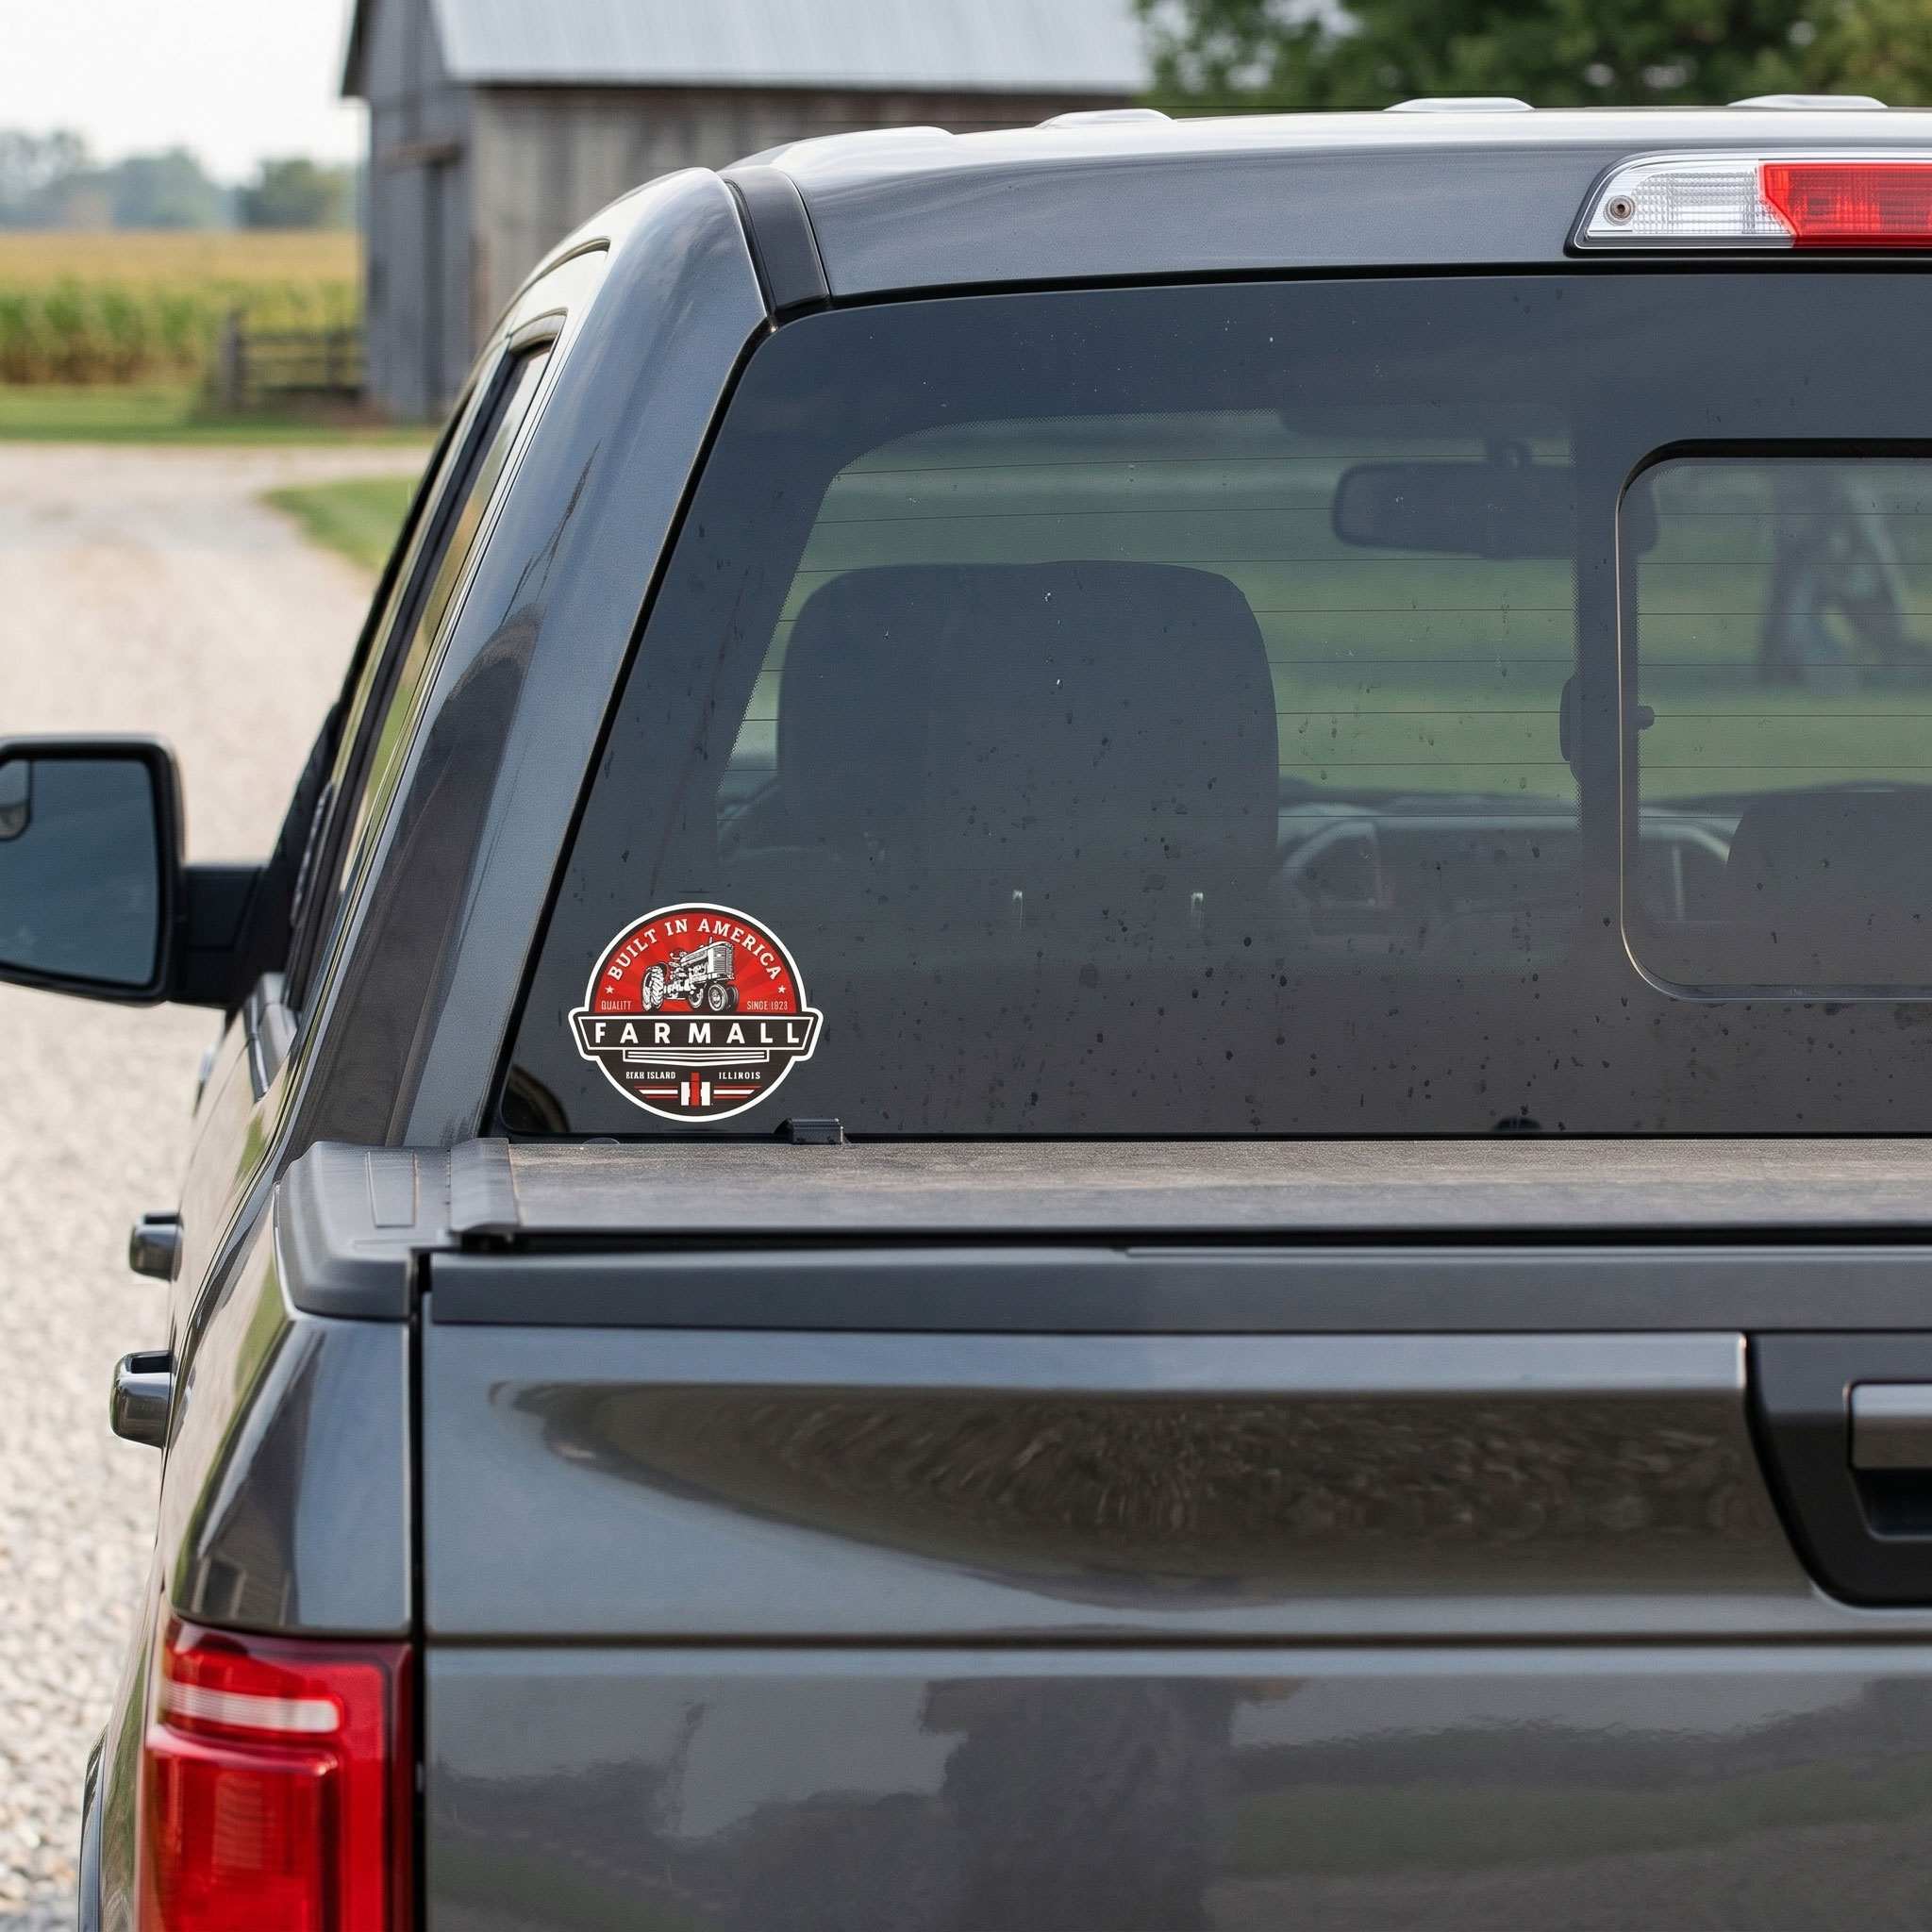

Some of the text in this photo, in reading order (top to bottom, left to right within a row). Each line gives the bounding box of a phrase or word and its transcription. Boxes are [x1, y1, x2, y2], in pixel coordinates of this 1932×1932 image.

[608, 918, 782, 980] BUILT IN AMERICA
[595, 1023, 800, 1044] FARMALL
[718, 1071, 761, 1080] ILLINOIS
